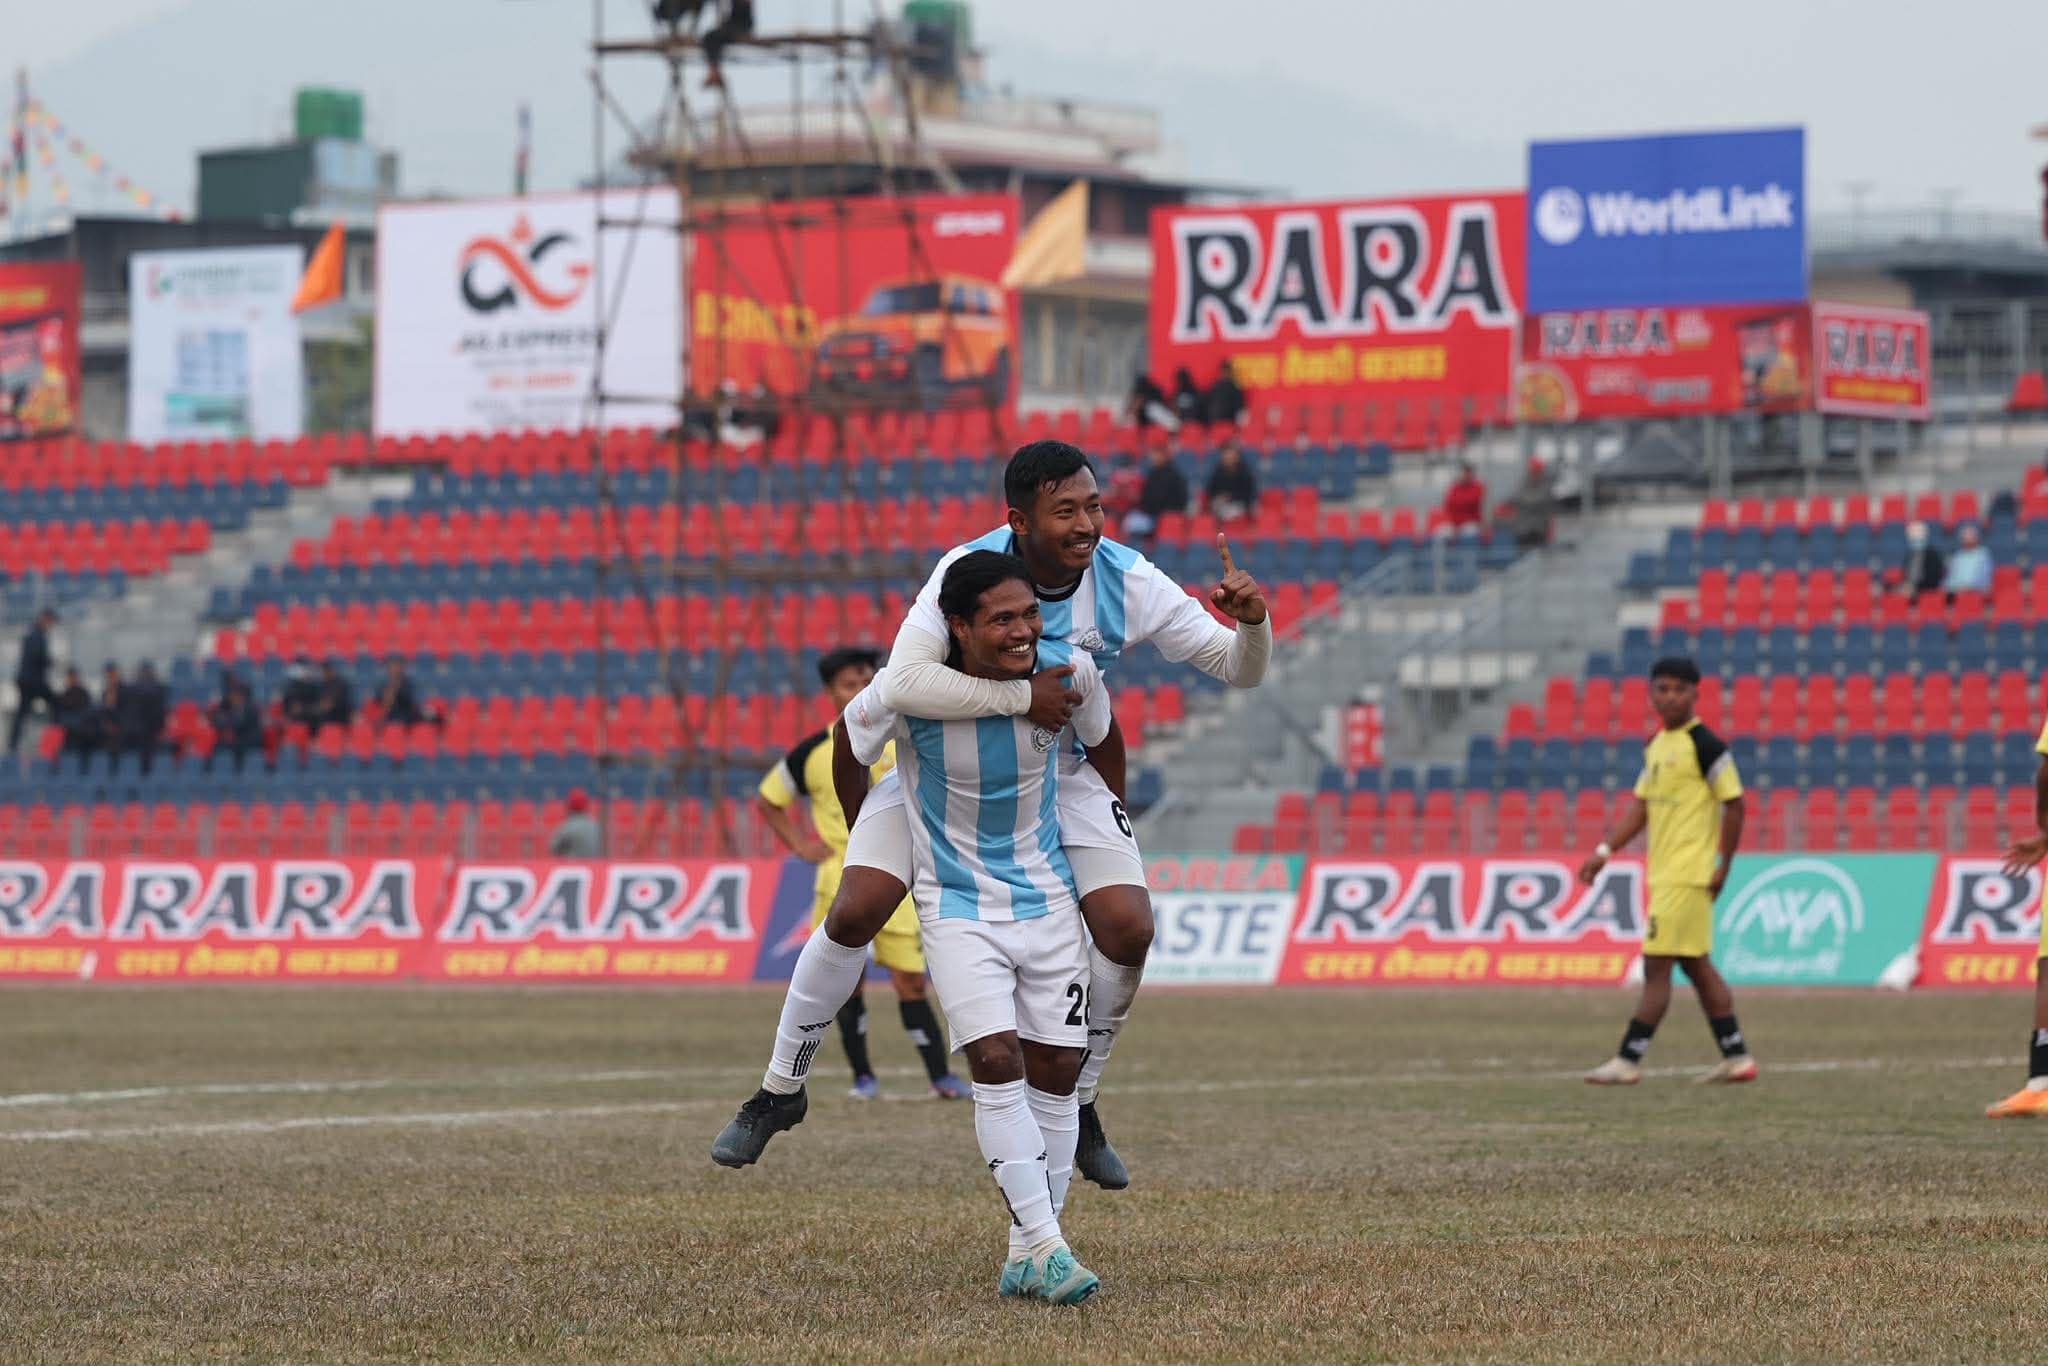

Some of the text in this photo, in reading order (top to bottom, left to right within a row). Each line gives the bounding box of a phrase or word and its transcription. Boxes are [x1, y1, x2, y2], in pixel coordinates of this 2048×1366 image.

[1586, 182, 1794, 236] WorldLink
[1172, 200, 1518, 341] RARA
[1540, 308, 1673, 357] RARA
[1824, 320, 1920, 375] RARA
[1111, 799, 1133, 838] 6
[107, 860, 421, 940] RARA
[438, 864, 753, 941] RARA
[1294, 861, 1646, 941] RARA
[1932, 860, 2044, 943] R
